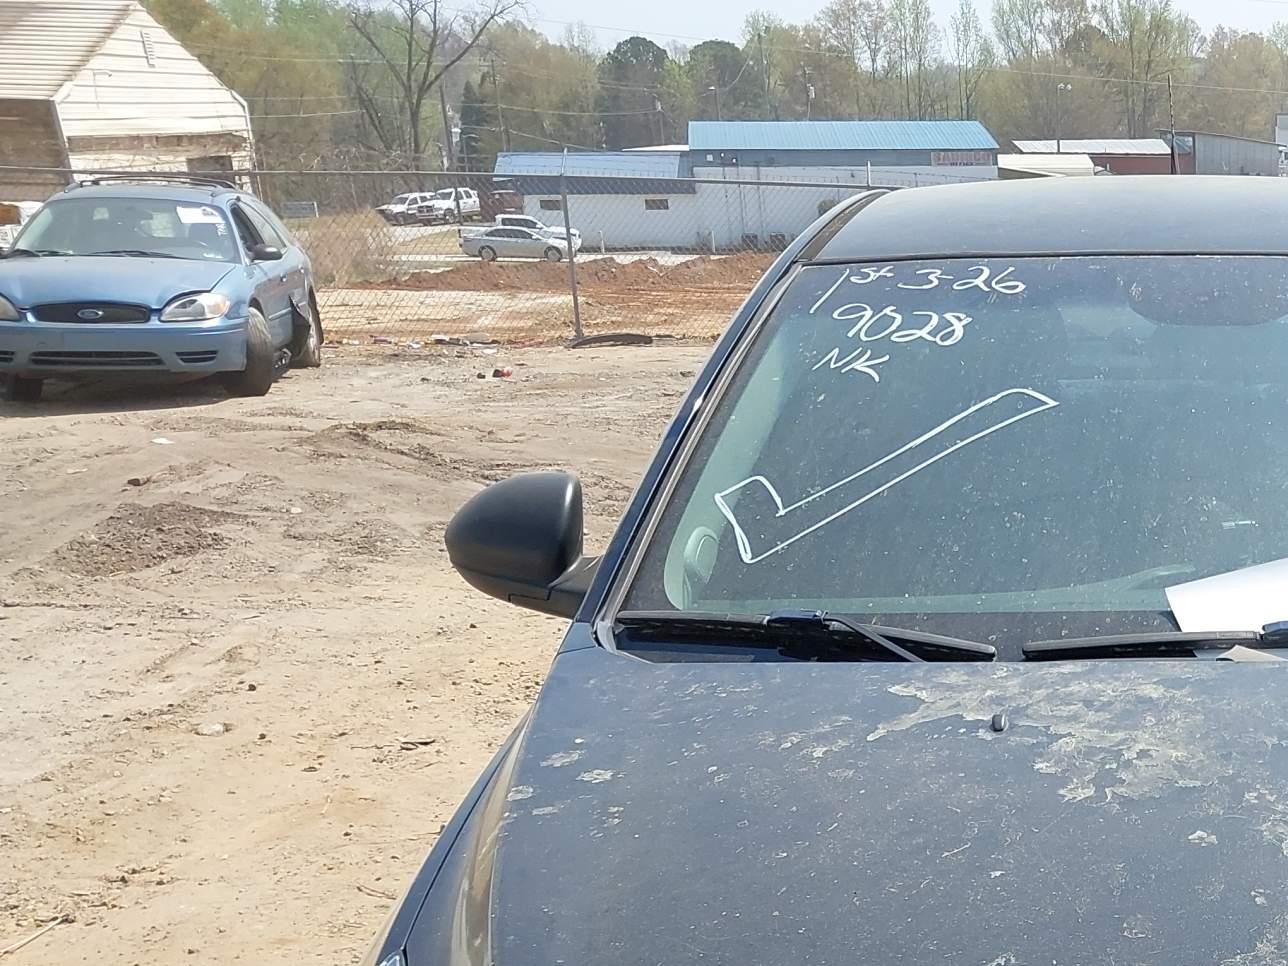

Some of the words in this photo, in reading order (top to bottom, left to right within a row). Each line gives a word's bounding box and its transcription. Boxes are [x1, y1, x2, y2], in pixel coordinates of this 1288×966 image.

[897, 266, 1026, 294] 3-26
[832, 303, 973, 346] 9028
[812, 347, 890, 383] NK
